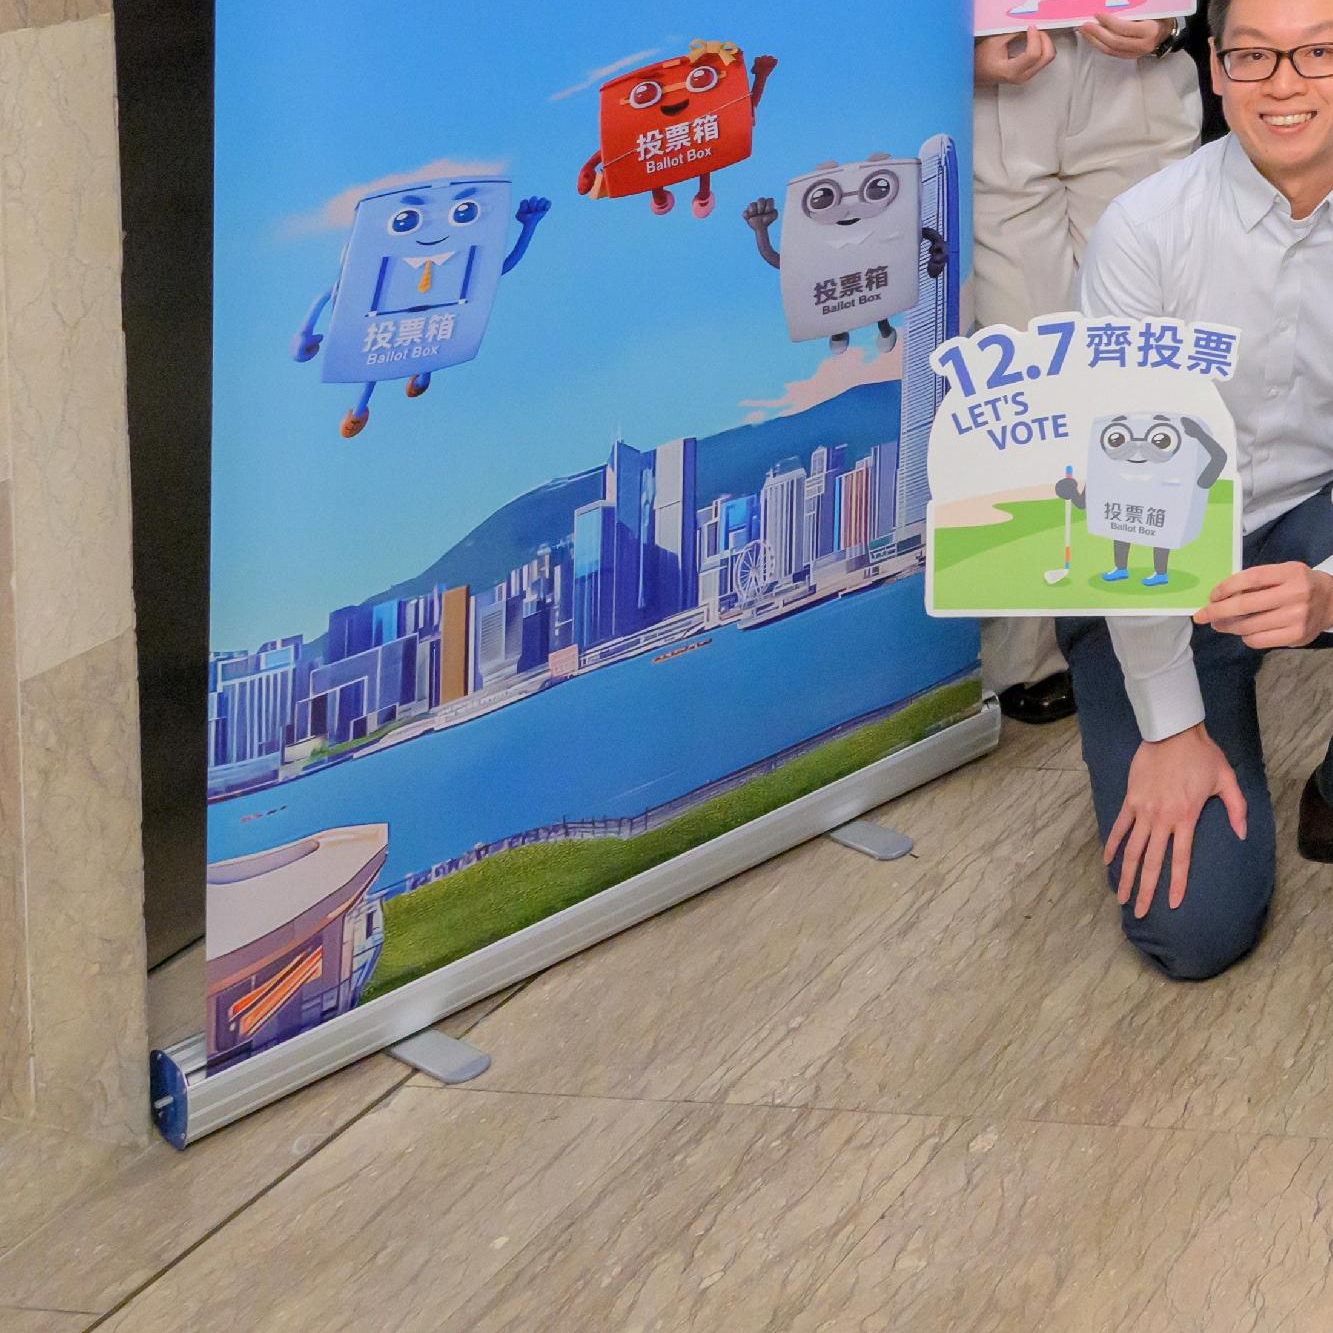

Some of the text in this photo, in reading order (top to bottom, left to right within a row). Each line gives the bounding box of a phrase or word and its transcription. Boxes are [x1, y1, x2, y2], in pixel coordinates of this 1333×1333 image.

[636, 114, 719, 162] 投票箱
[646, 147, 712, 174] Ballot Box
[813, 265, 889, 306] 投票箱
[822, 293, 882, 316] Ballot Box
[362, 313, 456, 353] 投票箱
[367, 344, 440, 365] Ballot Box
[938, 320, 1237, 398] 12.7 齊投票
[951, 391, 1030, 435] LET'S
[987, 413, 1070, 451] VOTE
[1103, 502, 1167, 529] 投票箱
[1110, 521, 1157, 537] Ballot Box
